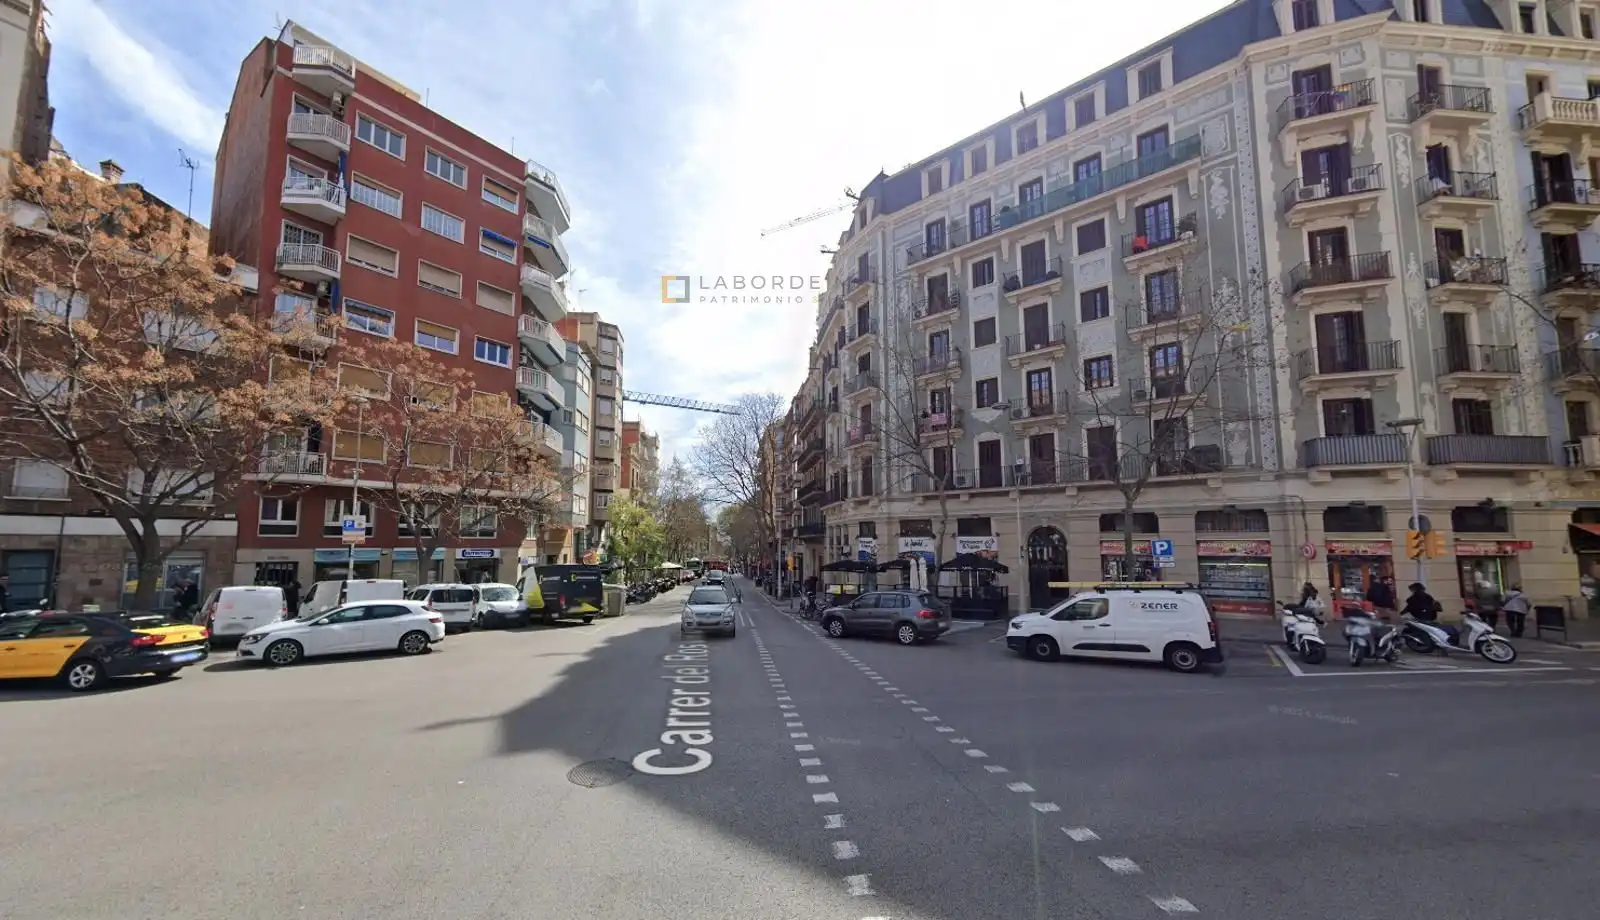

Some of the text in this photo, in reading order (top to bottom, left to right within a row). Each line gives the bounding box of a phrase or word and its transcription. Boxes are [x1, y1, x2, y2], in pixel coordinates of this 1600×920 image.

[1155, 541, 1169, 555] P
[1140, 602, 1179, 610] ZENER
[660, 665, 710, 684] del
[631, 688, 714, 776] Carrer
